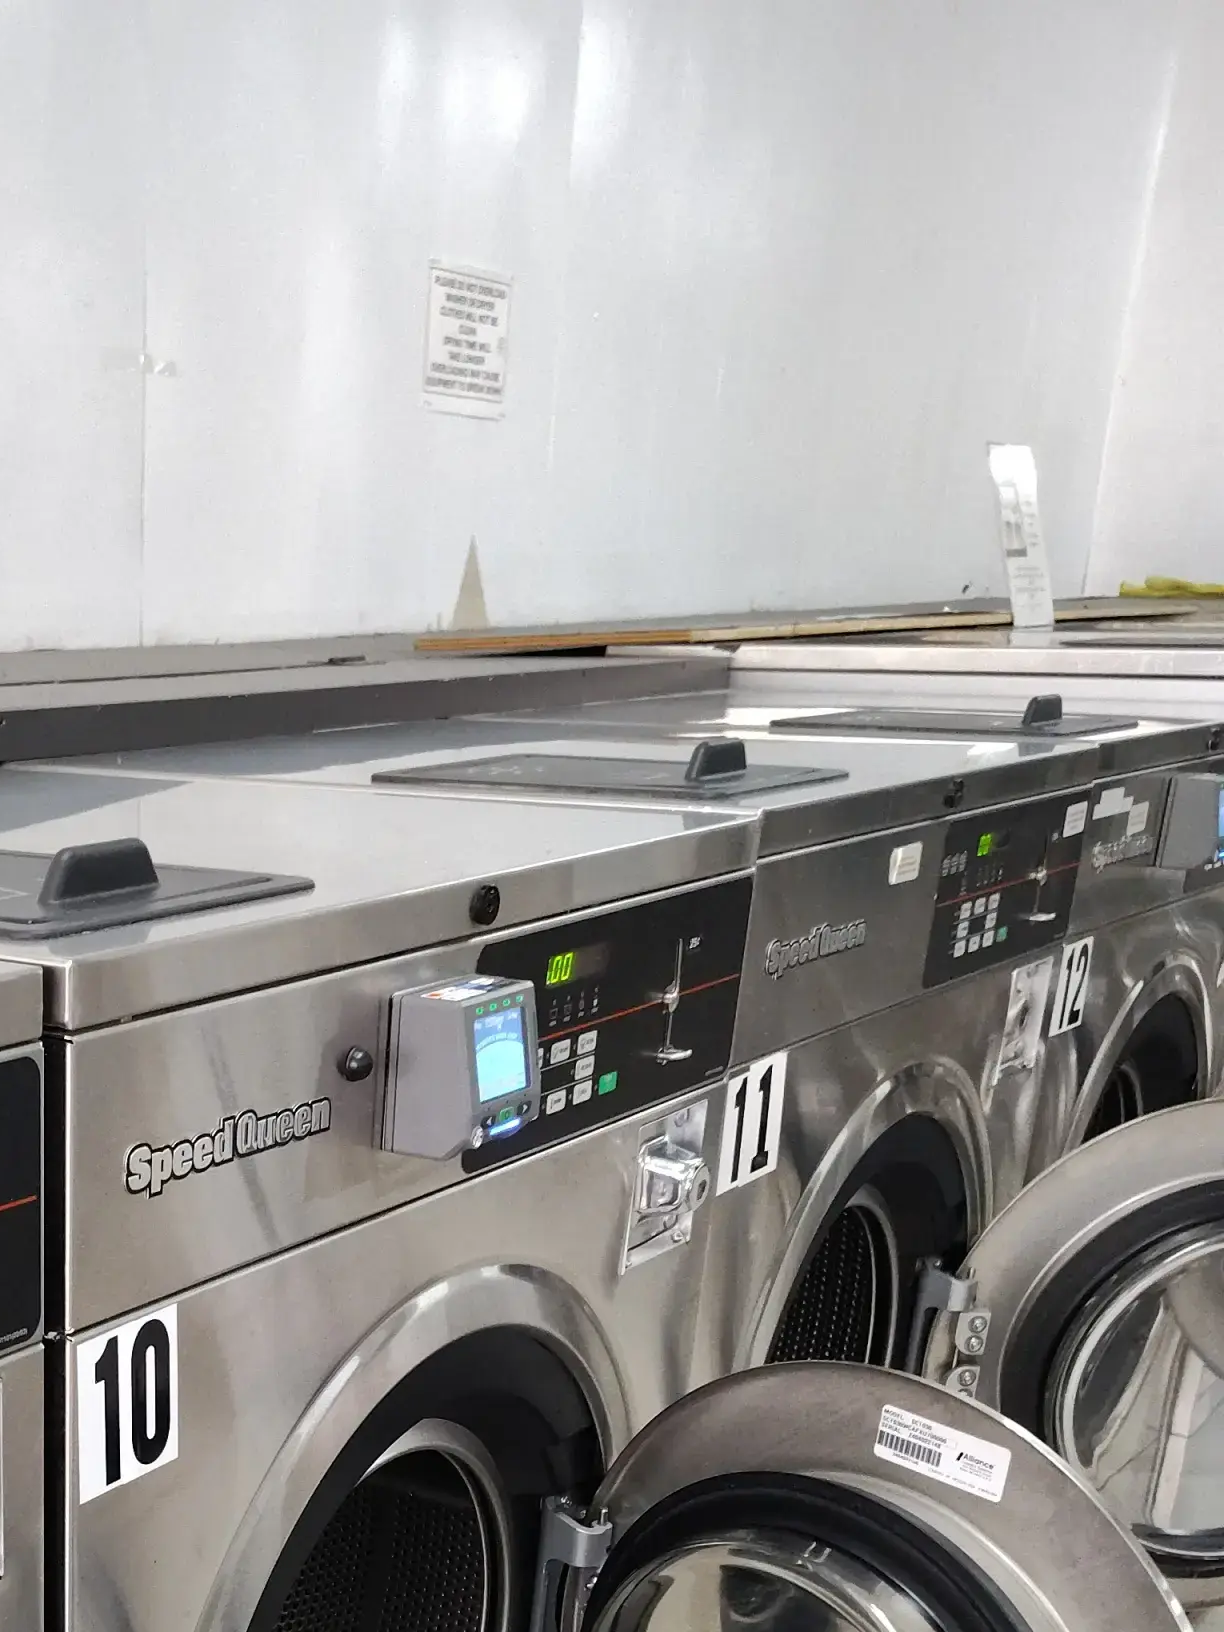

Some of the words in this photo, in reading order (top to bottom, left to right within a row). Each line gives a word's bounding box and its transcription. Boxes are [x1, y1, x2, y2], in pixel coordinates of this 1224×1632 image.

[764, 926, 820, 980] Speed
[819, 919, 867, 958] Queen
[1058, 943, 1089, 1030] 12
[123, 1117, 237, 1199] Speed
[234, 1097, 332, 1157] Queen
[734, 1063, 774, 1184] 11
[94, 1317, 171, 1487] 10
[963, 1452, 995, 1470] Alliance
